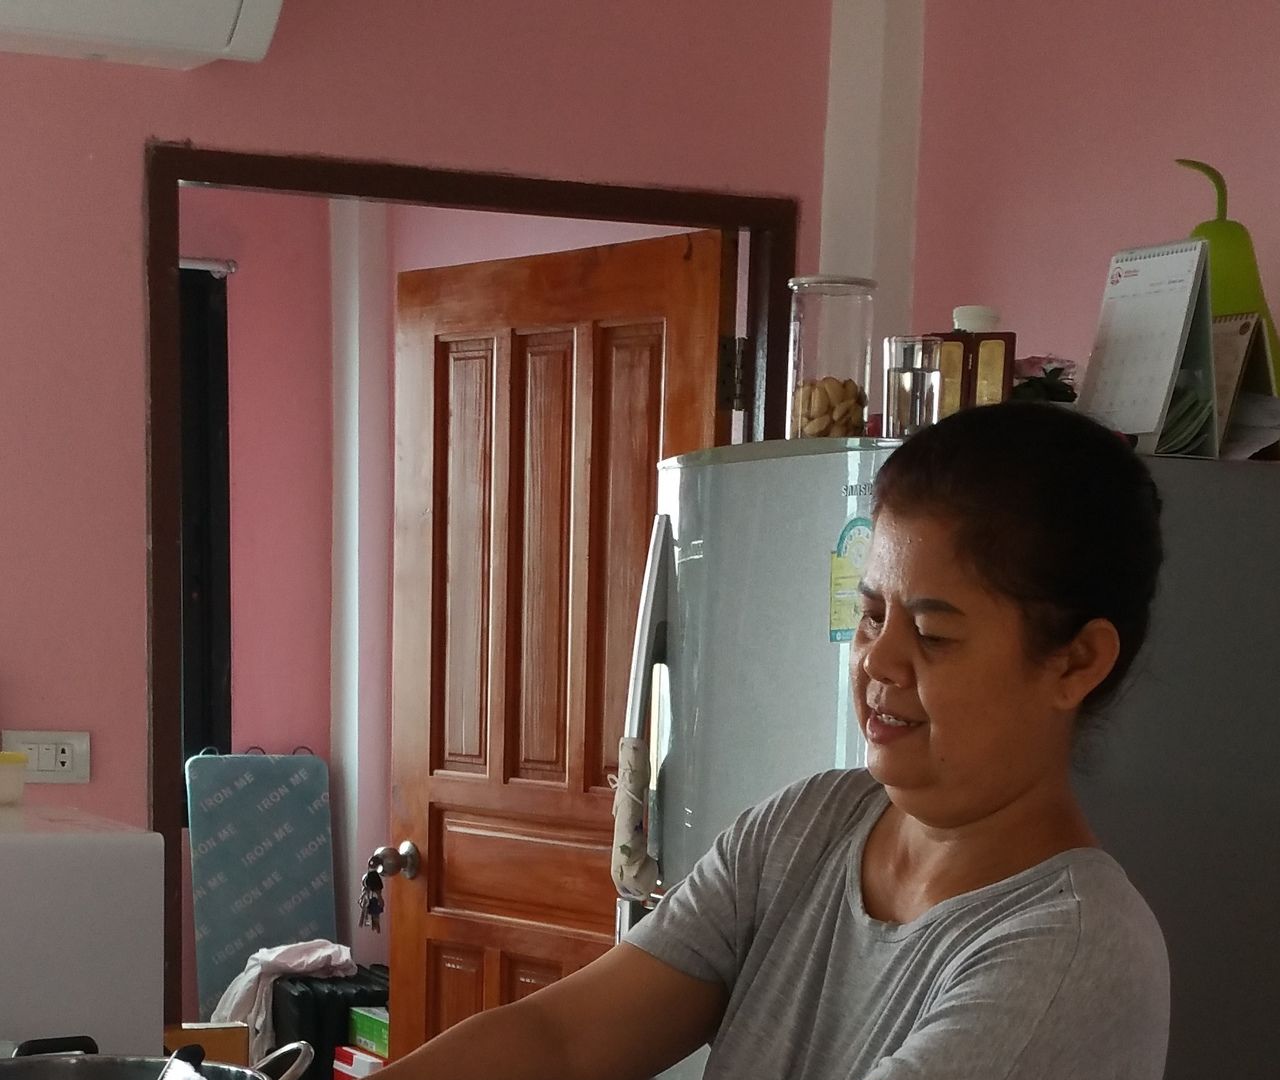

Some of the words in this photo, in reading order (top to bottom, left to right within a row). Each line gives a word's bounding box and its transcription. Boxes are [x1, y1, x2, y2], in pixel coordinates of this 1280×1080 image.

[841, 483, 873, 498] SAMSU
[200, 785, 233, 812] IRON
[234, 771, 255, 790] ME
[256, 784, 290, 814] IRON
[289, 767, 310, 786] ME
[219, 823, 238, 842] ME
[241, 838, 273, 867] IRON
[273, 822, 295, 842] ME
[231, 888, 263, 914] IRON
[262, 871, 284, 890] ME
